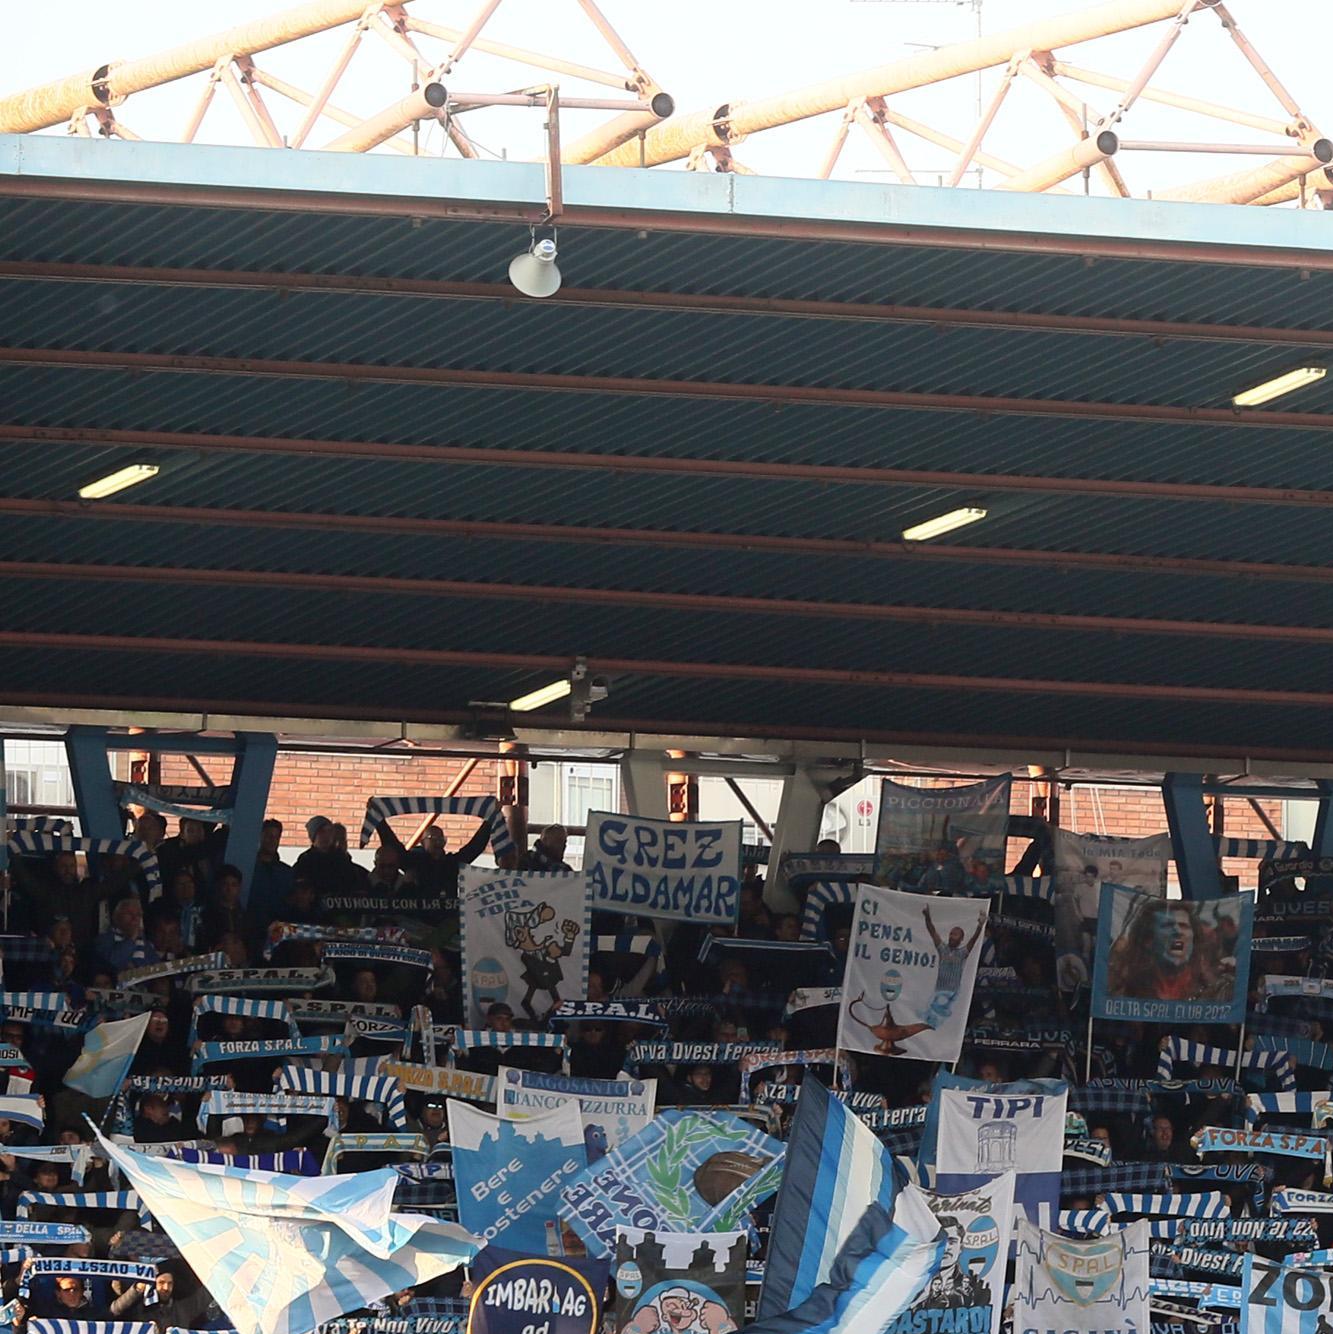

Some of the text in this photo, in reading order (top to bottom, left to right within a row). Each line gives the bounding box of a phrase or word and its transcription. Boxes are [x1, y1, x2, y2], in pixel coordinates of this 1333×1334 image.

[598, 819, 724, 869] GREZ
[465, 877, 528, 901] SOTA
[481, 890, 520, 906] CHI
[590, 869, 737, 917] ALDAMAR
[861, 899, 879, 915] CI
[858, 921, 913, 942] PENSA
[854, 947, 936, 968] IL GENIO!
[1106, 999, 1140, 1017] DELTA
[1143, 1003, 1172, 1018] SPAL
[1176, 1004, 1201, 1018] CLUB
[219, 1041, 259, 1053] FORZA
[524, 1072, 628, 1096] LAGOSANTO
[968, 1095, 1044, 1118] TIPI
[1208, 1129, 1273, 1147] FORZA
[471, 1157, 523, 1202] Bere
[1056, 1252, 1113, 1273] SPAL
